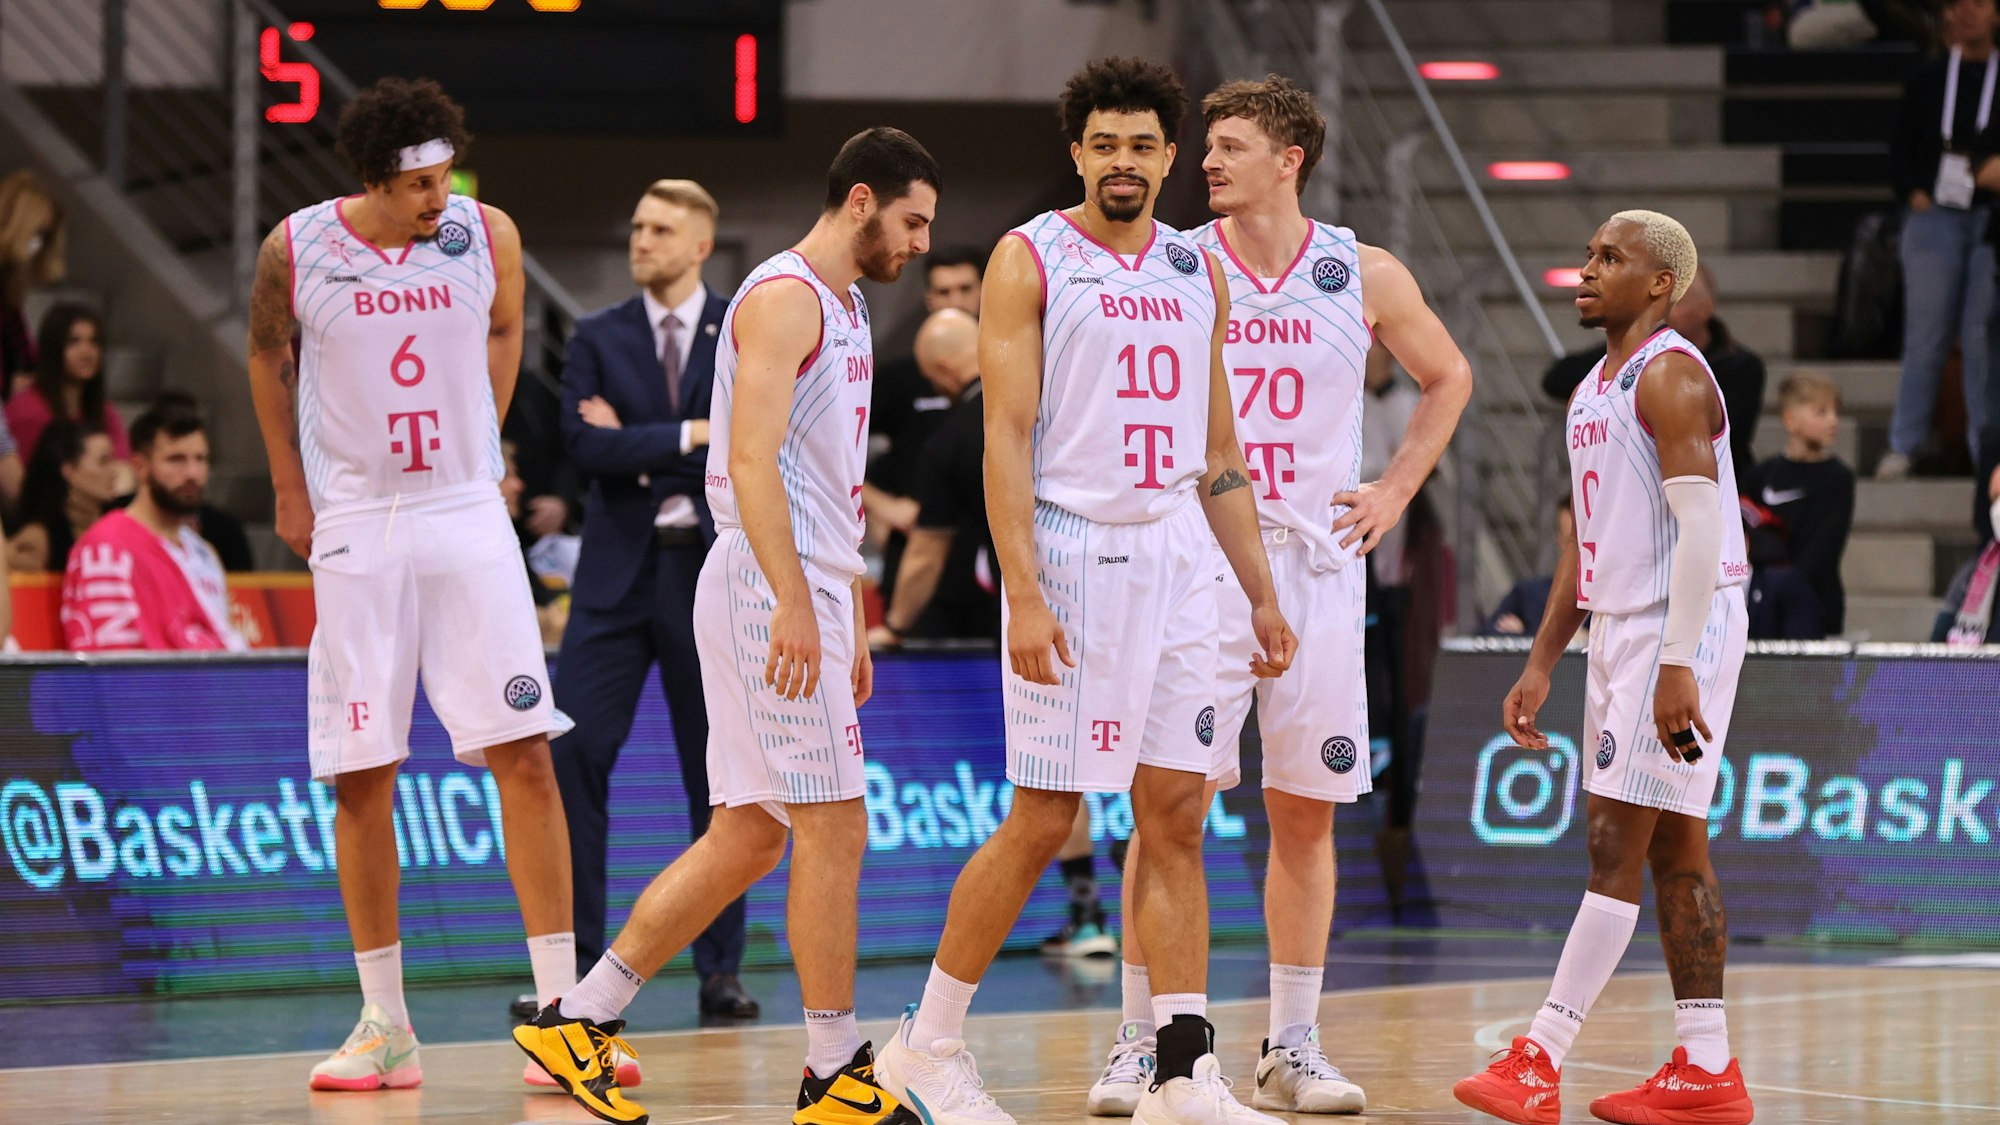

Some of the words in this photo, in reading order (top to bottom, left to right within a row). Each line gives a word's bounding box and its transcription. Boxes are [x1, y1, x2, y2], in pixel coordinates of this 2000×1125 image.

[260, 22, 320, 123] 5
[1069, 276, 1104, 286] SPALDING
[354, 285, 452, 316] BONN
[1100, 294, 1183, 322] BONN
[1225, 319, 1312, 344] BONN
[390, 334, 425, 387] 6
[1117, 344, 1181, 401] 10
[1234, 367, 1304, 420] 70
[387, 410, 440, 473] T
[856, 407, 866, 452] 7
[1124, 424, 1174, 489] T
[1245, 442, 1296, 501] T
[1098, 555, 1129, 565] SPALDIN
[1722, 561, 1748, 577] Telek
[816, 587, 842, 607] SPALDI
[1092, 720, 1120, 752] T
[1707, 753, 2000, 844] Bask
[0, 772, 506, 890] @BasketllC
[605, 952, 634, 980] LDING
[1677, 1002, 1724, 1010] SPALDIN
